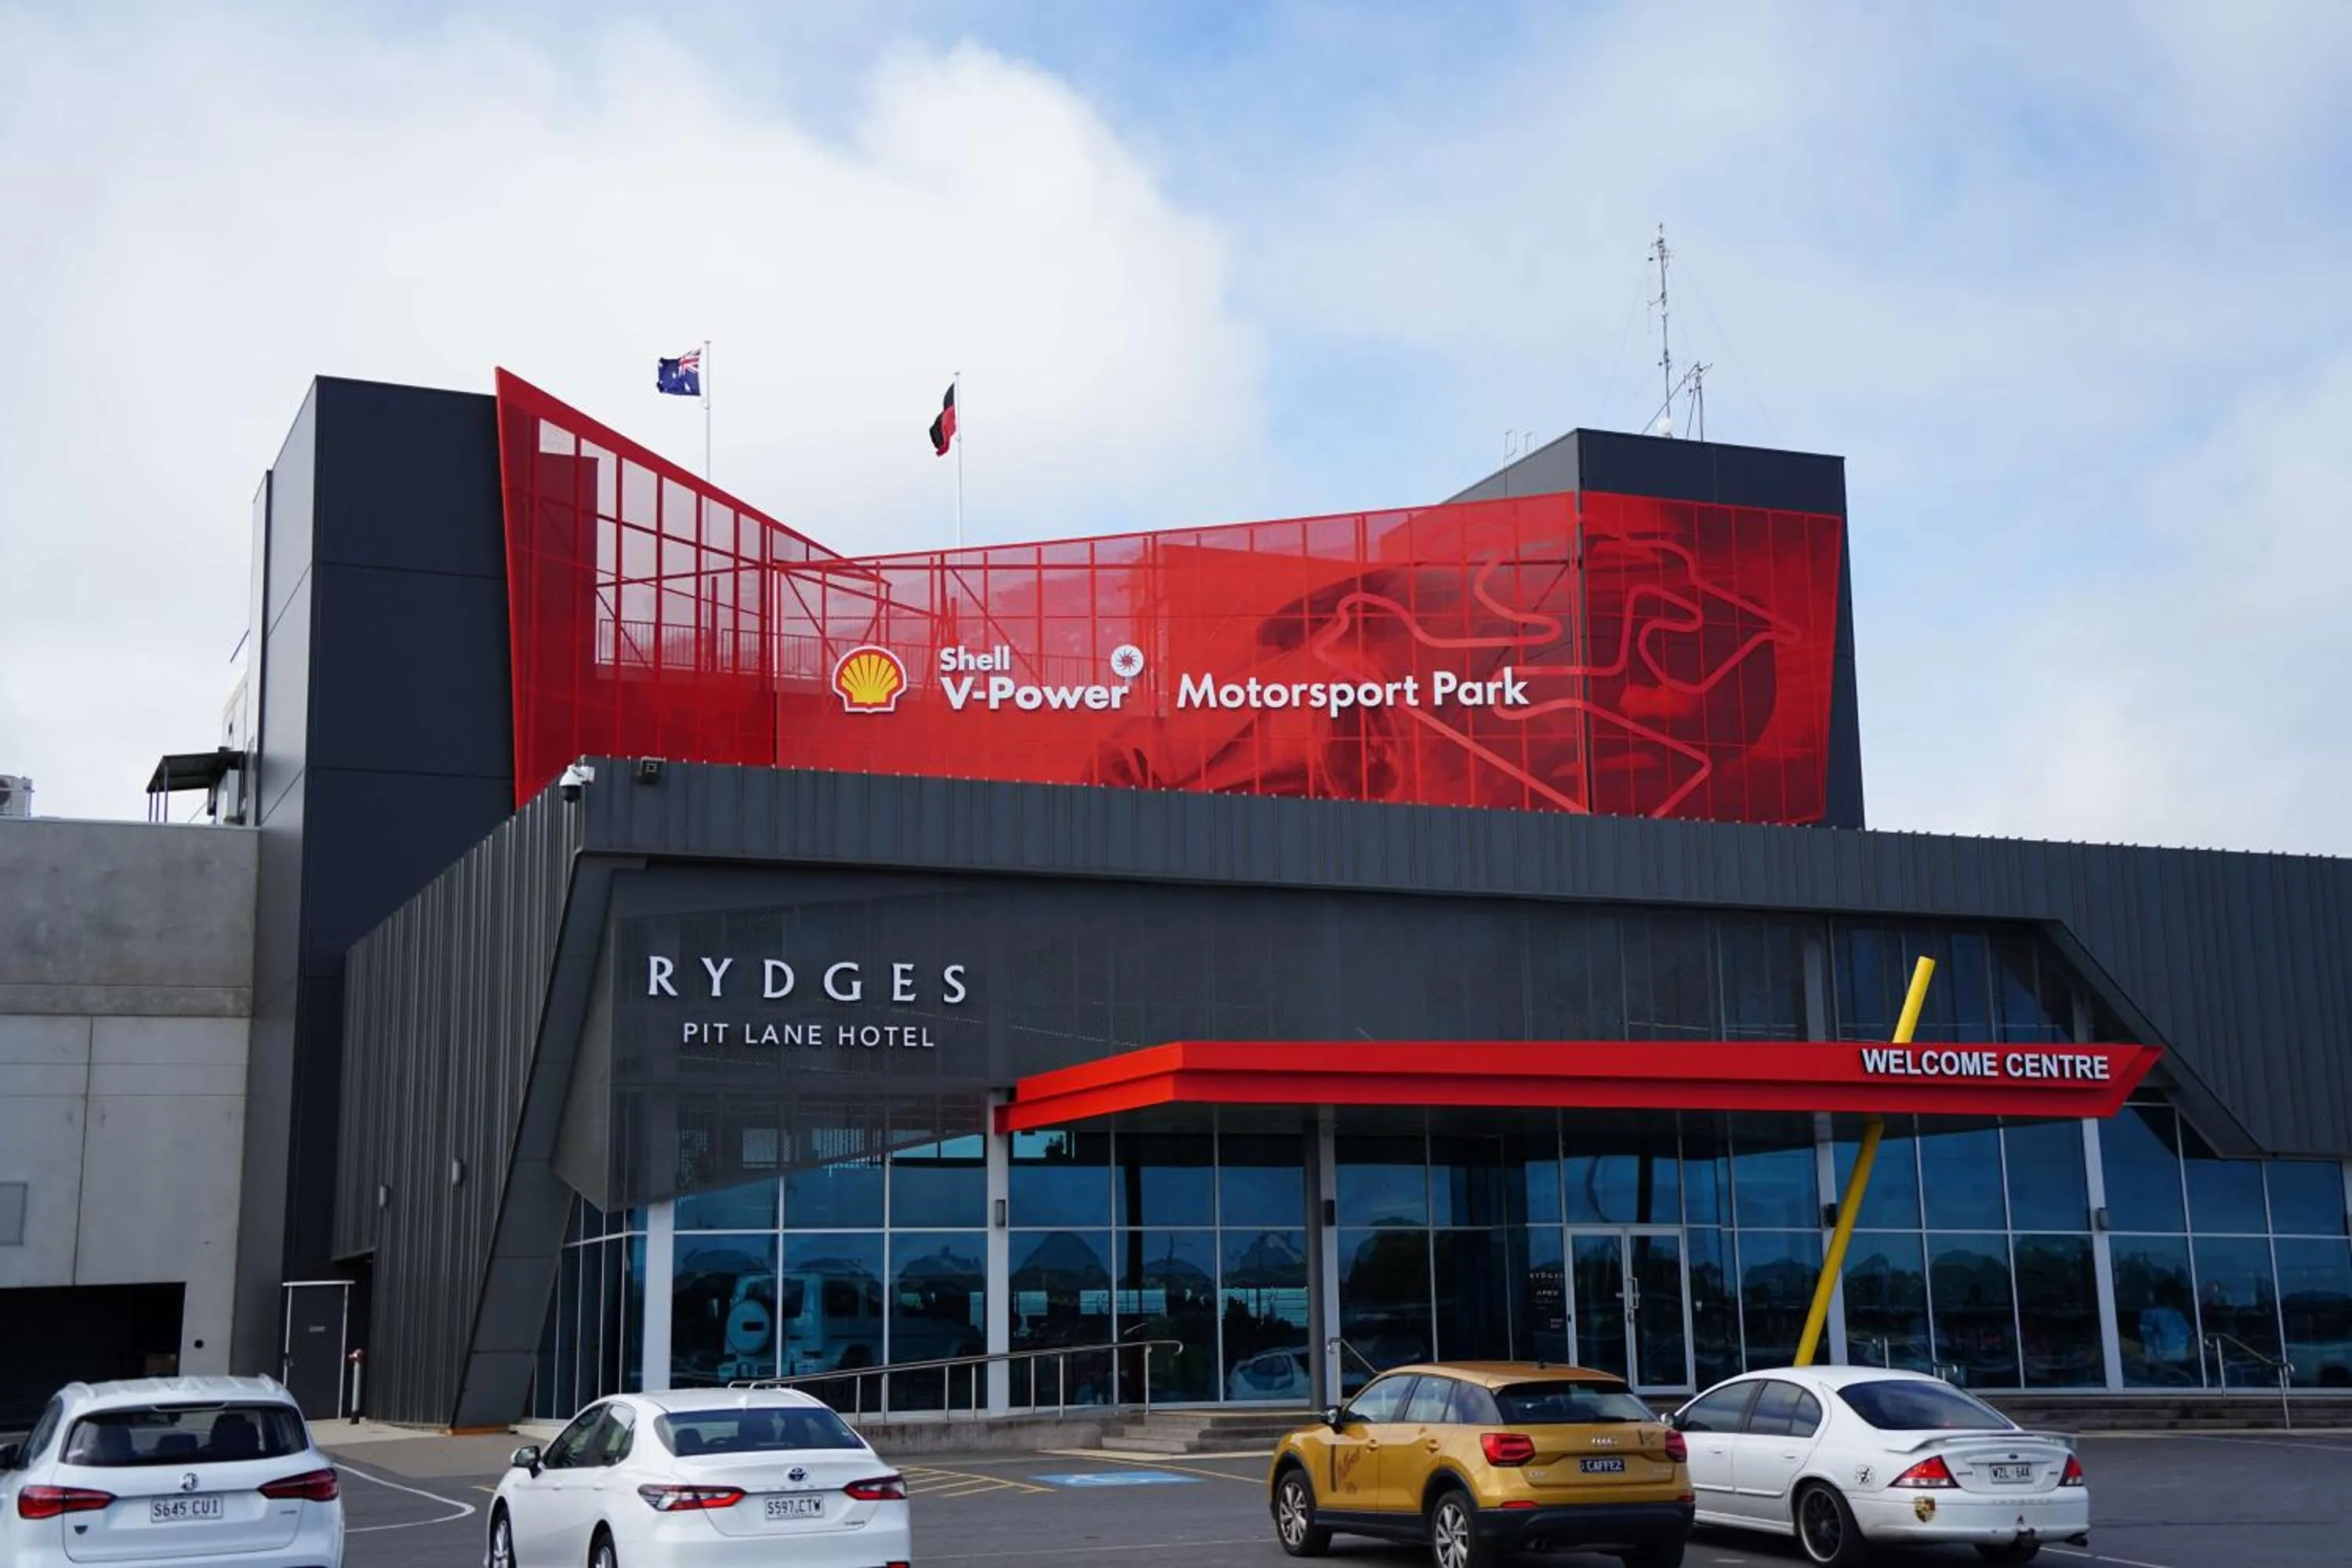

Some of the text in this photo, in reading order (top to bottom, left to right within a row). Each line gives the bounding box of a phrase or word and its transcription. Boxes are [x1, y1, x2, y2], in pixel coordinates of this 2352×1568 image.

[941, 645, 1011, 671] Shell
[941, 677, 1129, 710] V-Power
[1177, 666, 1530, 717] Motorsport Park
[648, 955, 967, 1004] RYDGES
[682, 1022, 935, 1047] PIT LANE HOTEL
[1861, 1048, 2111, 1080] WELCOME CENTRE
